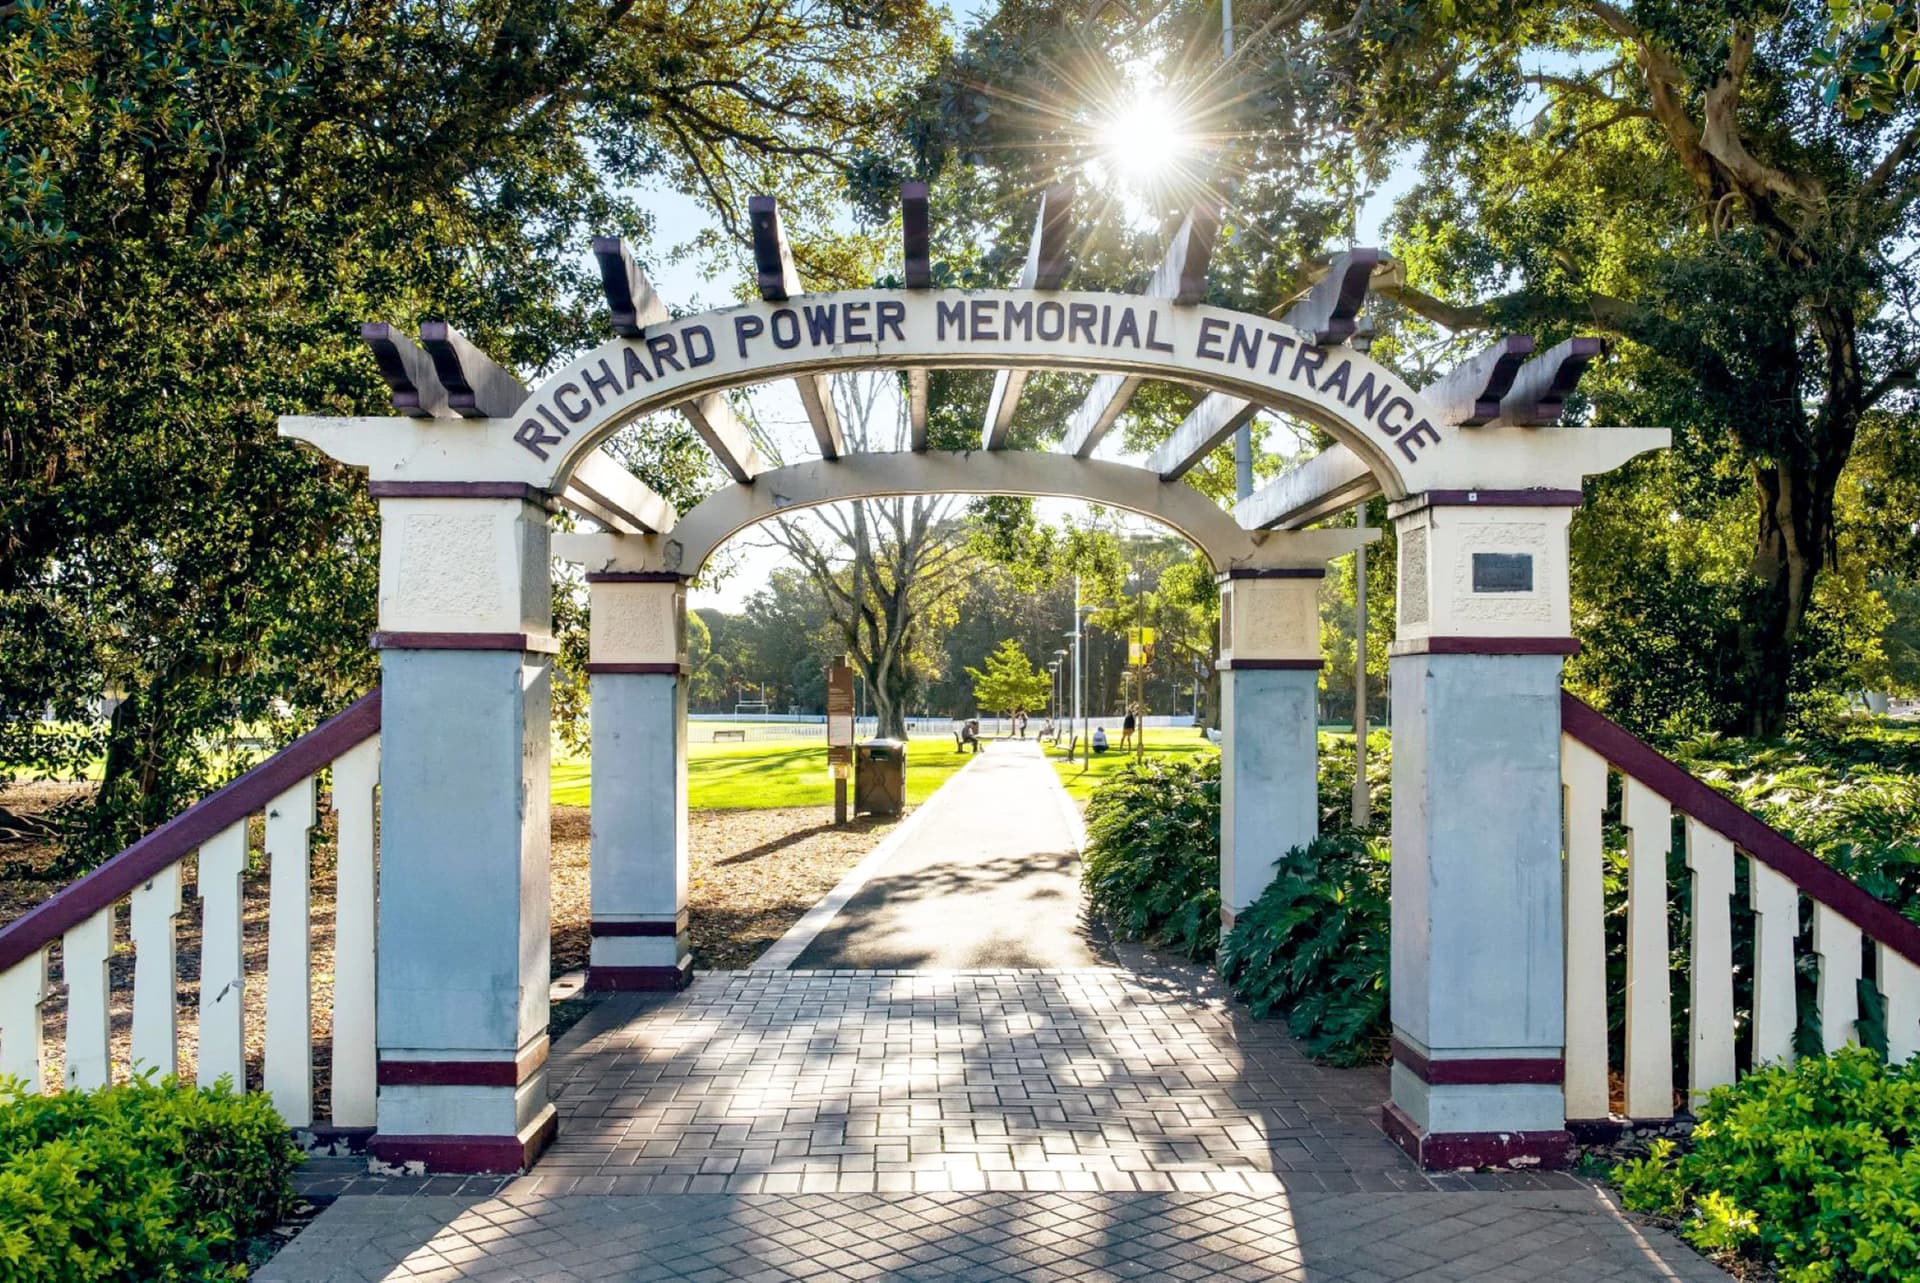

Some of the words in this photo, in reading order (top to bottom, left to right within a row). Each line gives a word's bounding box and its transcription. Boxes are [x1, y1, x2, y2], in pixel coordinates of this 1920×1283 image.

[513, 324, 716, 462] RICHARD
[734, 301, 906, 358] POWER
[937, 300, 1174, 353] MEMORIAL
[1196, 318, 1442, 463] ENTRANCE
